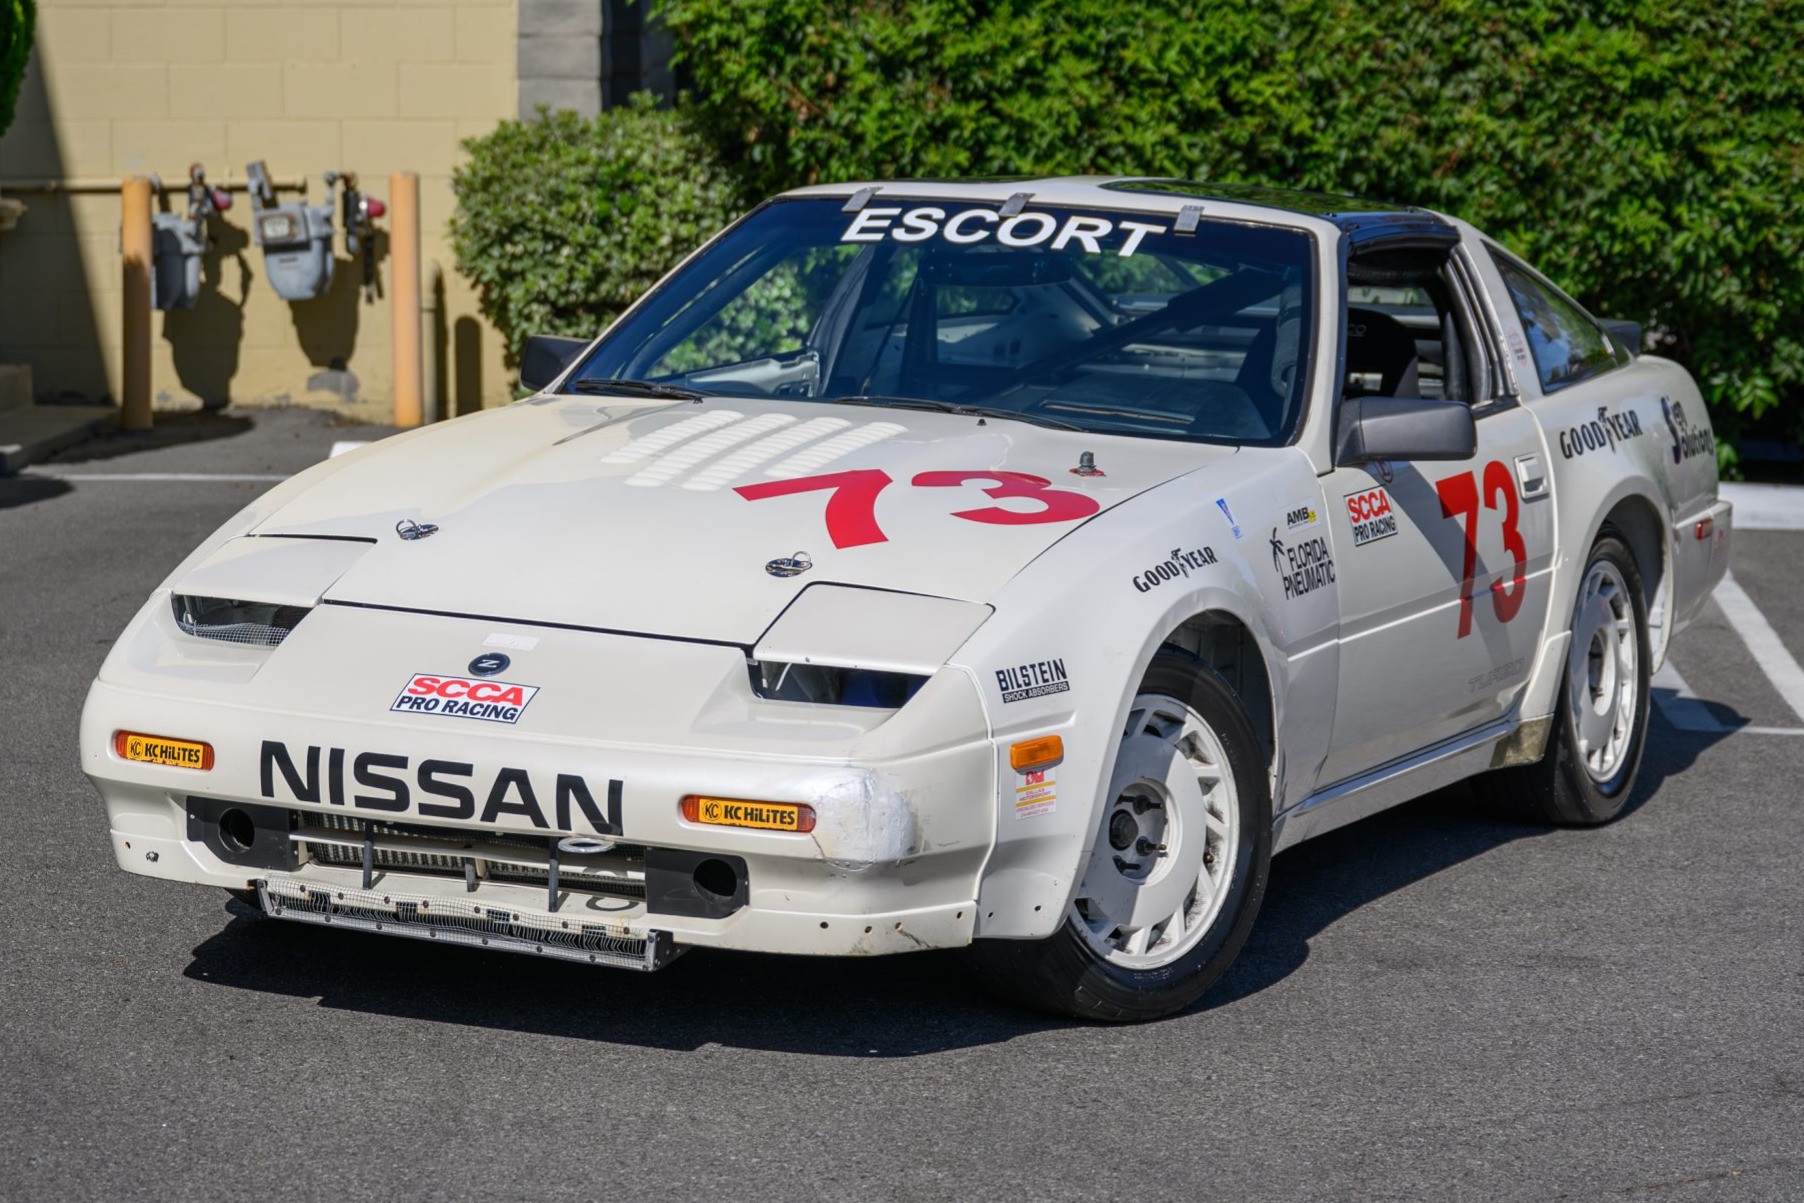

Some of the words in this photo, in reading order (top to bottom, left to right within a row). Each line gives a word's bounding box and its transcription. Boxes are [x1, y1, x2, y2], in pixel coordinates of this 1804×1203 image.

[841, 207, 1167, 257] ESCORT
[1560, 409, 1643, 459] GOODYEAR
[732, 469, 1100, 549] 73
[1287, 507, 1310, 526] AMB
[1347, 489, 1392, 523] SCCA
[1354, 523, 1370, 542] PRO
[1369, 515, 1396, 537] RACING
[1287, 537, 1329, 571] FLORIDA
[1436, 461, 1527, 639] 73
[1133, 547, 1218, 592] GOODYEAR
[1283, 559, 1335, 600] PNEUMATIC
[407, 677, 523, 706] SCCA
[995, 658, 1067, 692] BILSTEIN
[1003, 689, 1028, 702] SHOCK
[1029, 682, 1068, 697] ABSORBERS
[396, 695, 439, 711] PRO
[441, 699, 519, 720] RACING
[260, 739, 624, 837] NISSAN
